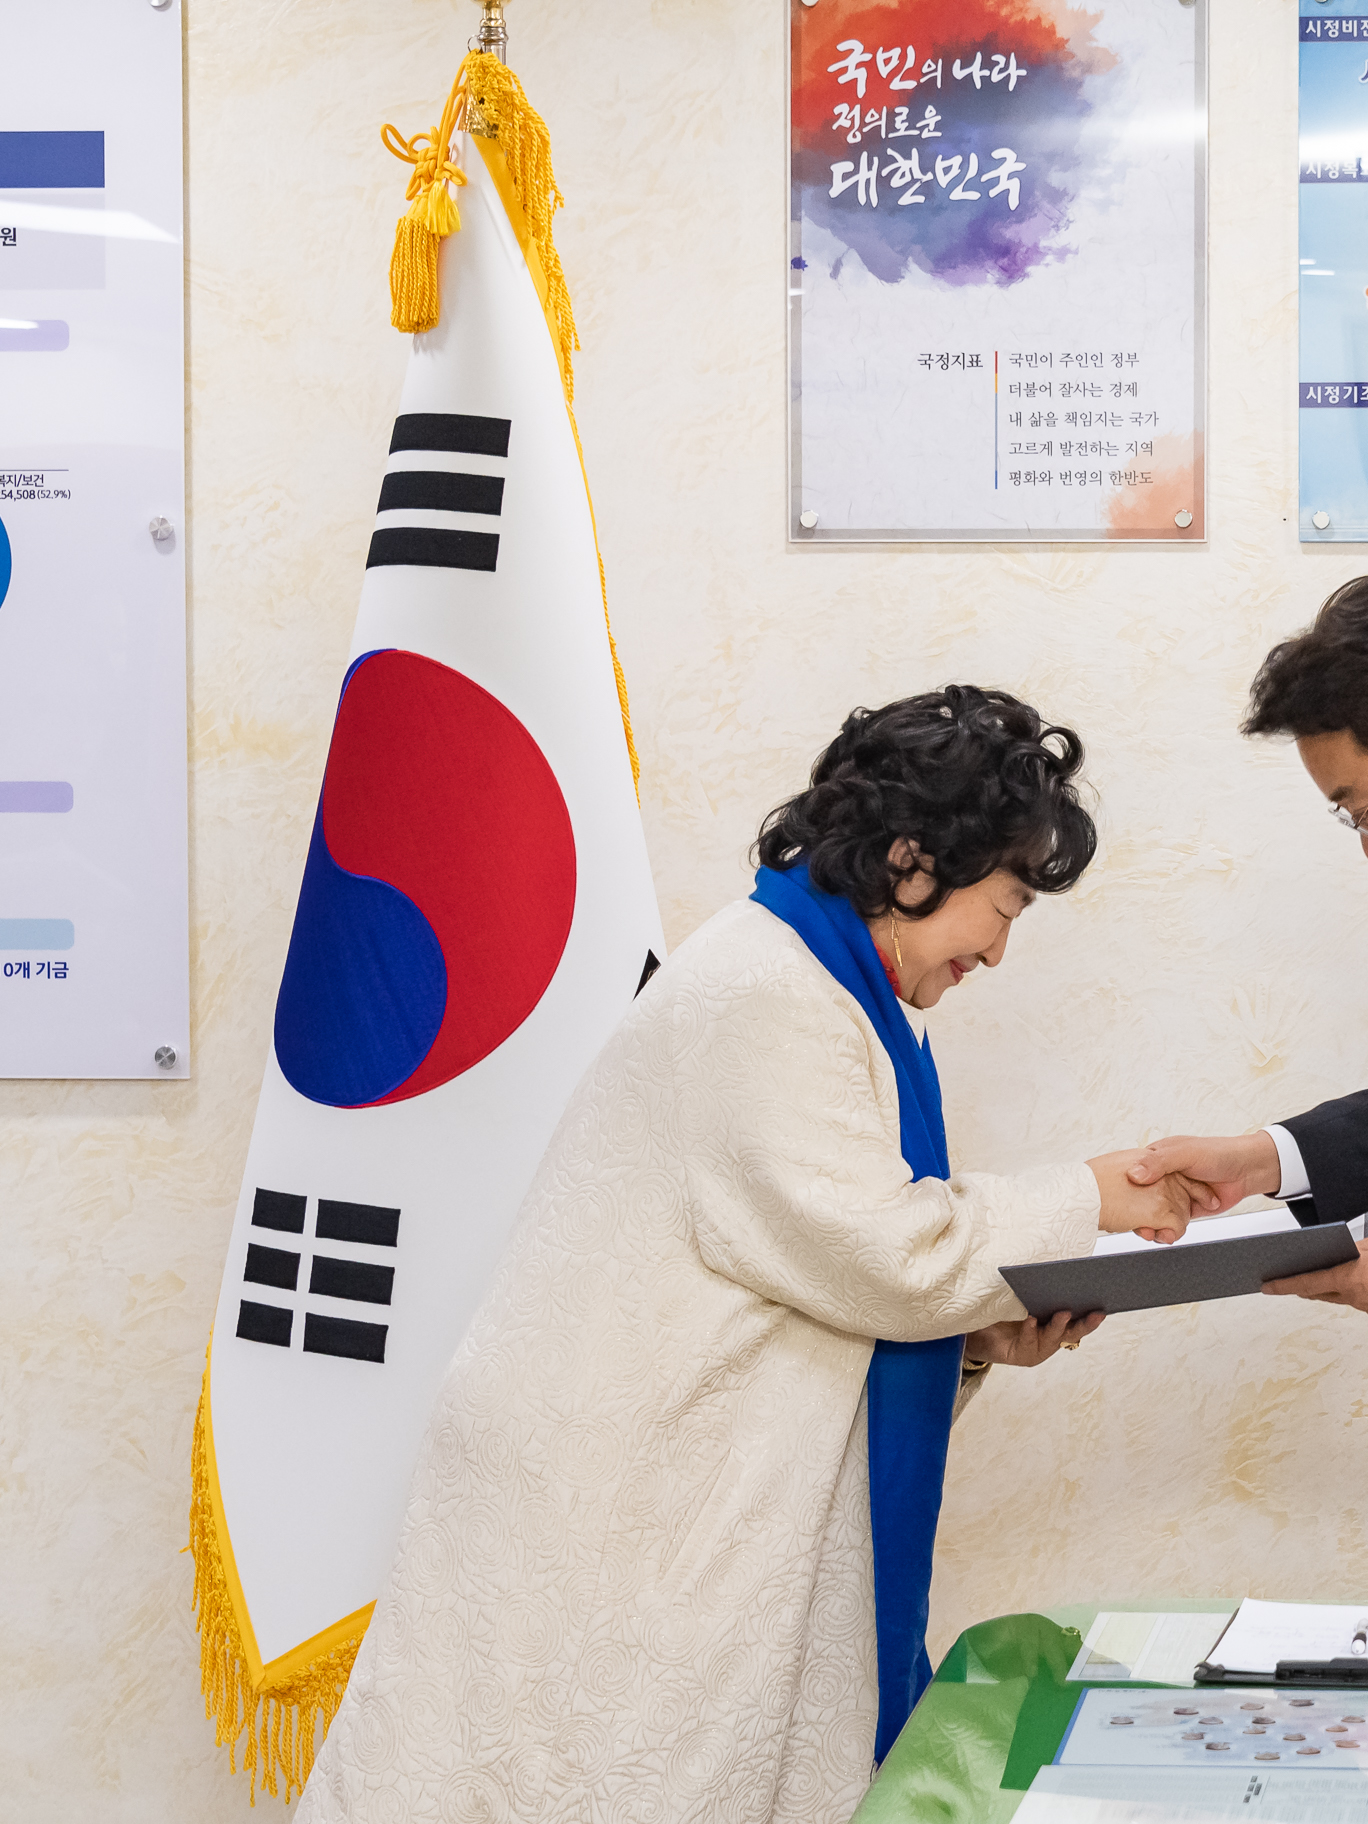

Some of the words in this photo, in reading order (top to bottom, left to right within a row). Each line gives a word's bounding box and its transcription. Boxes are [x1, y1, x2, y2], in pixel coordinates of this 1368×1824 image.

[827, 39, 942, 98] 국민의
[952, 52, 1027, 91] 나라
[831, 103, 942, 144] 정의로운
[828, 148, 1027, 210] 대한민국
[917, 352, 984, 371] 국정지표
[1009, 352, 1053, 368] 국민이
[1059, 351, 1103, 369] 주인인
[1111, 352, 1140, 369] 정부
[1009, 381, 1052, 398] 더불어
[1059, 381, 1104, 398] 잘사는
[1110, 381, 1138, 398] 경제
[1009, 411, 1022, 428] 내
[1028, 411, 1059, 428] 삶을
[1064, 411, 1122, 428] 책임지는
[1129, 411, 1160, 428] 국가
[1009, 440, 1053, 457] 고르게
[1059, 440, 1120, 457] 발전하는
[1125, 440, 1153, 458] 지역
[1009, 470, 1054, 487] 평화와
[1059, 469, 1102, 487] 번영의
[1108, 470, 1154, 487] 한반도
[35, 961, 70, 980] 기금
